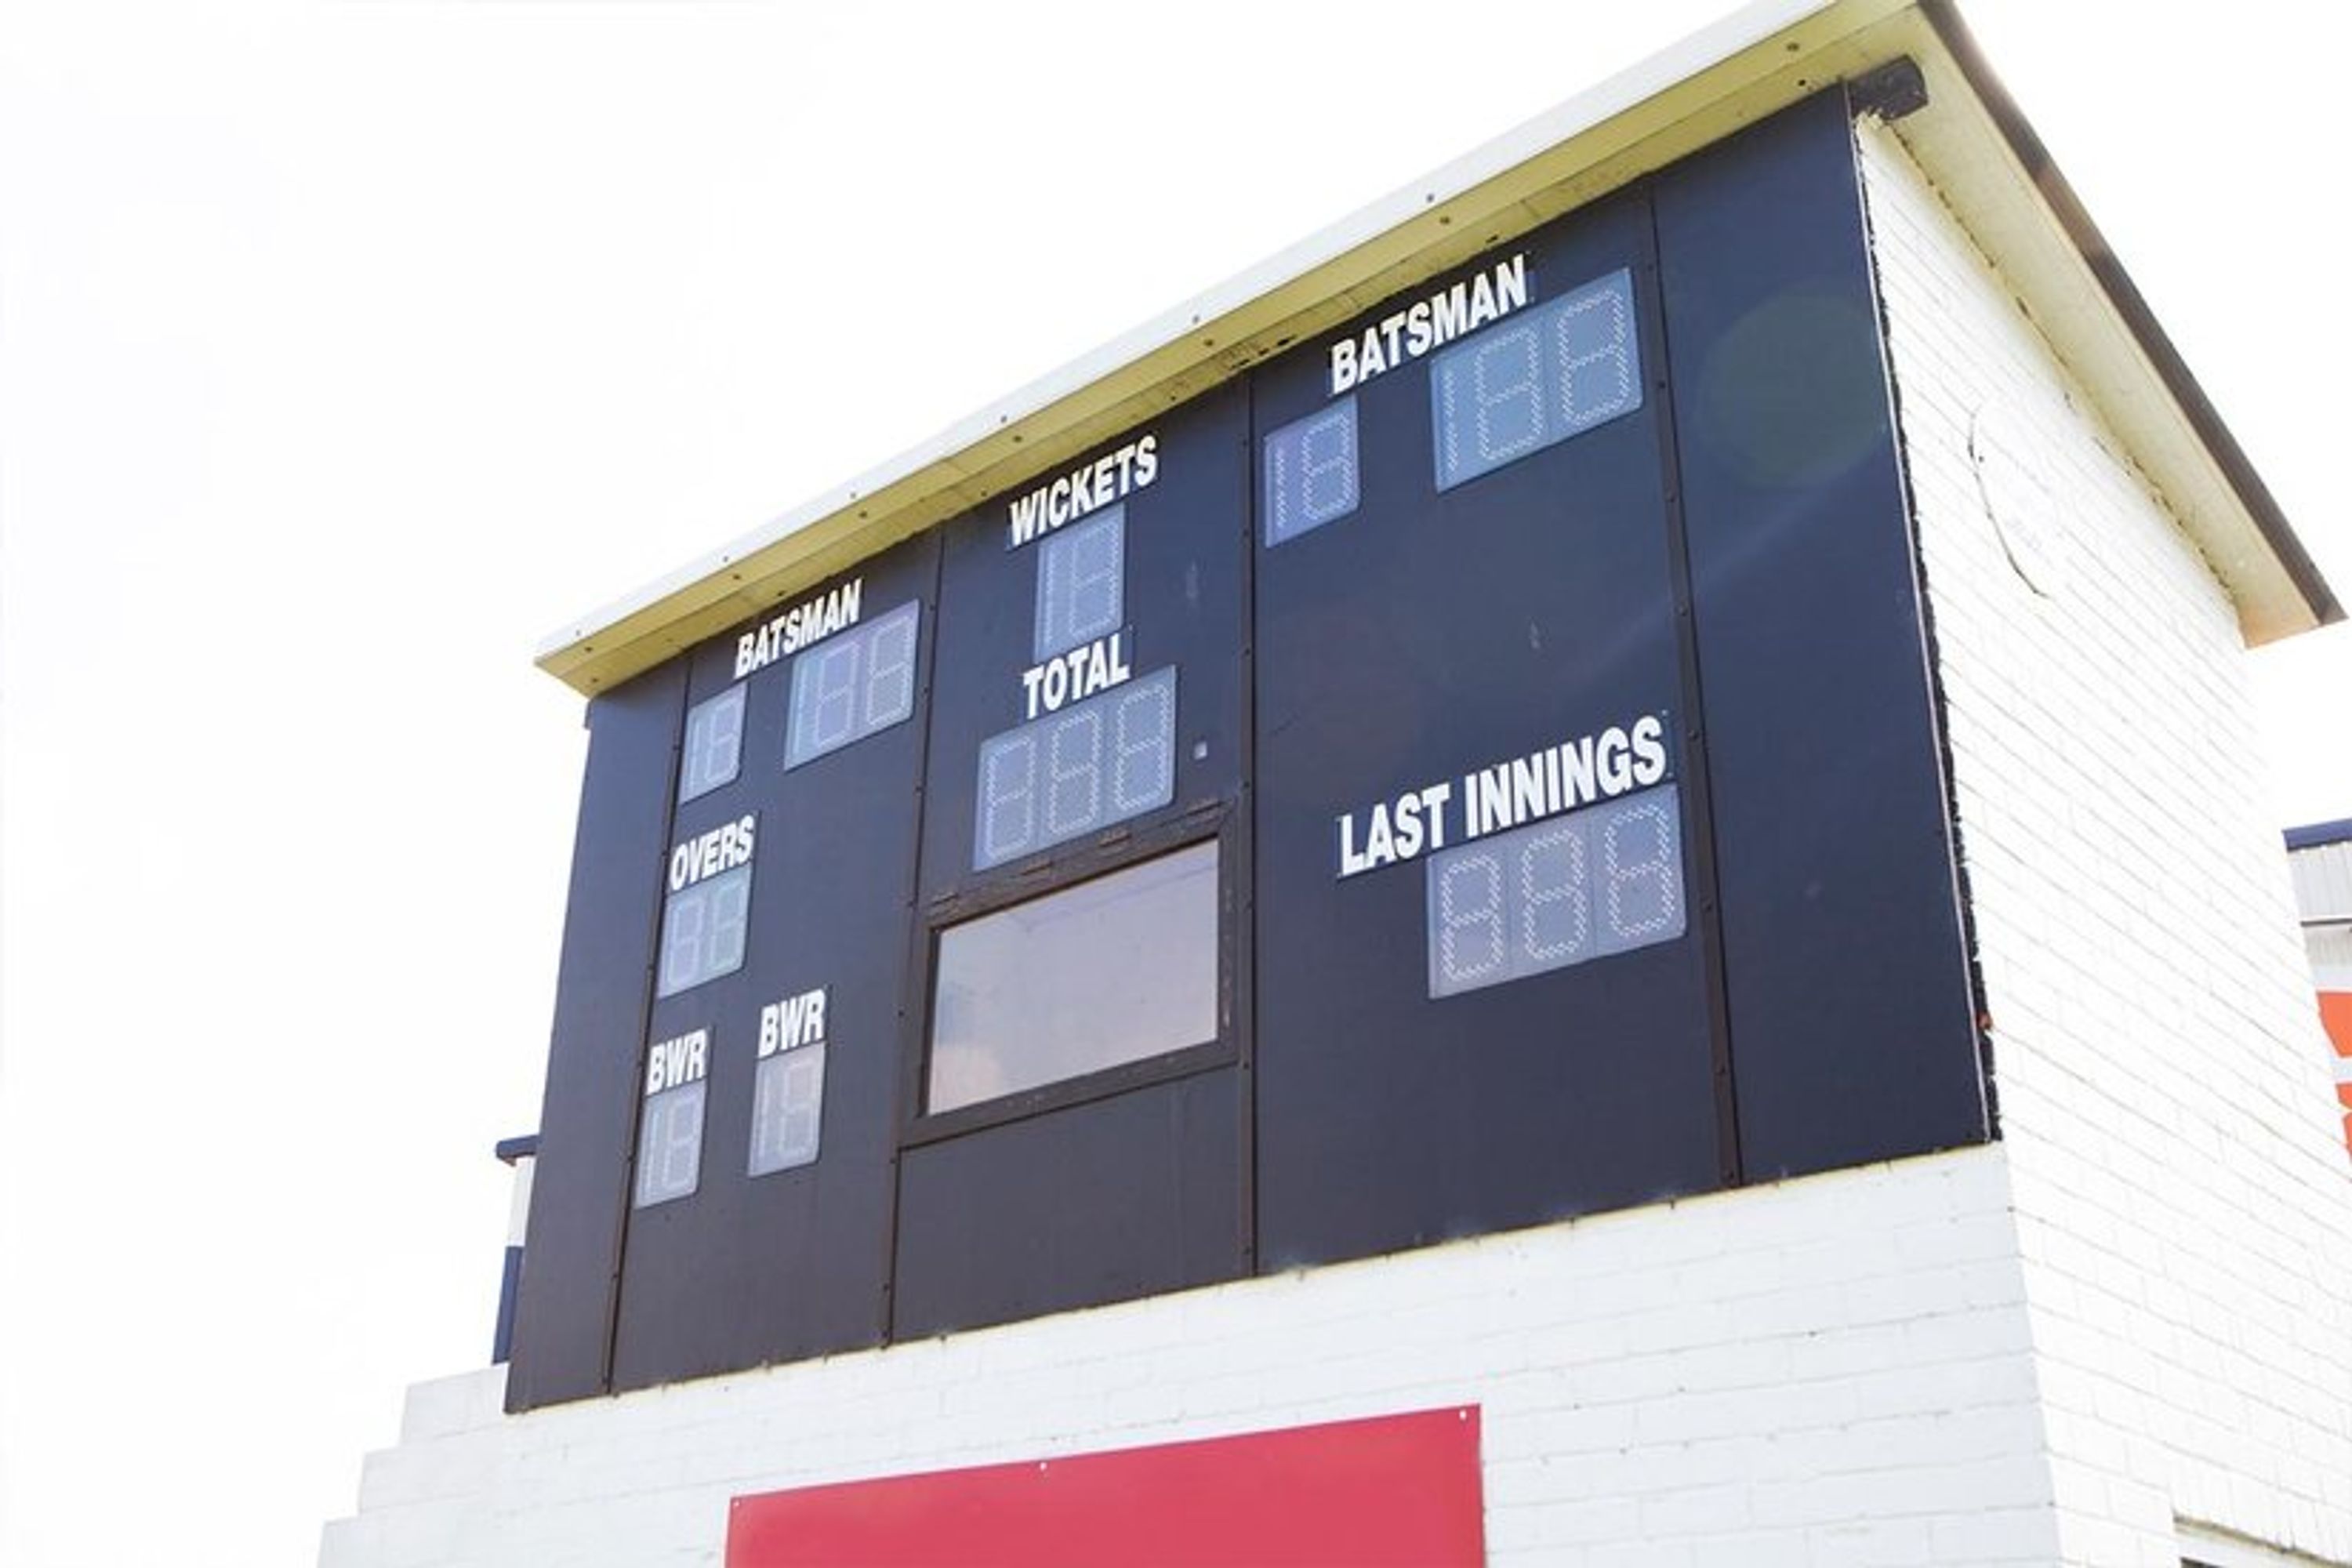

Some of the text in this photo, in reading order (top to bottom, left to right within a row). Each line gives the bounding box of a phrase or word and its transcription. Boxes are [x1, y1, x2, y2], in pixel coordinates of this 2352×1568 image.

[1331, 254, 1528, 394] BATSMAN
[1010, 434, 1158, 549] WICKETS
[734, 579, 862, 679] BATSMAN
[1023, 633, 1131, 720] TOTAL
[1341, 715, 1667, 878] LAST INNINGS
[669, 815, 755, 891] OVERS
[646, 1029, 707, 1095] BWR
[758, 989, 826, 1058] BWR
